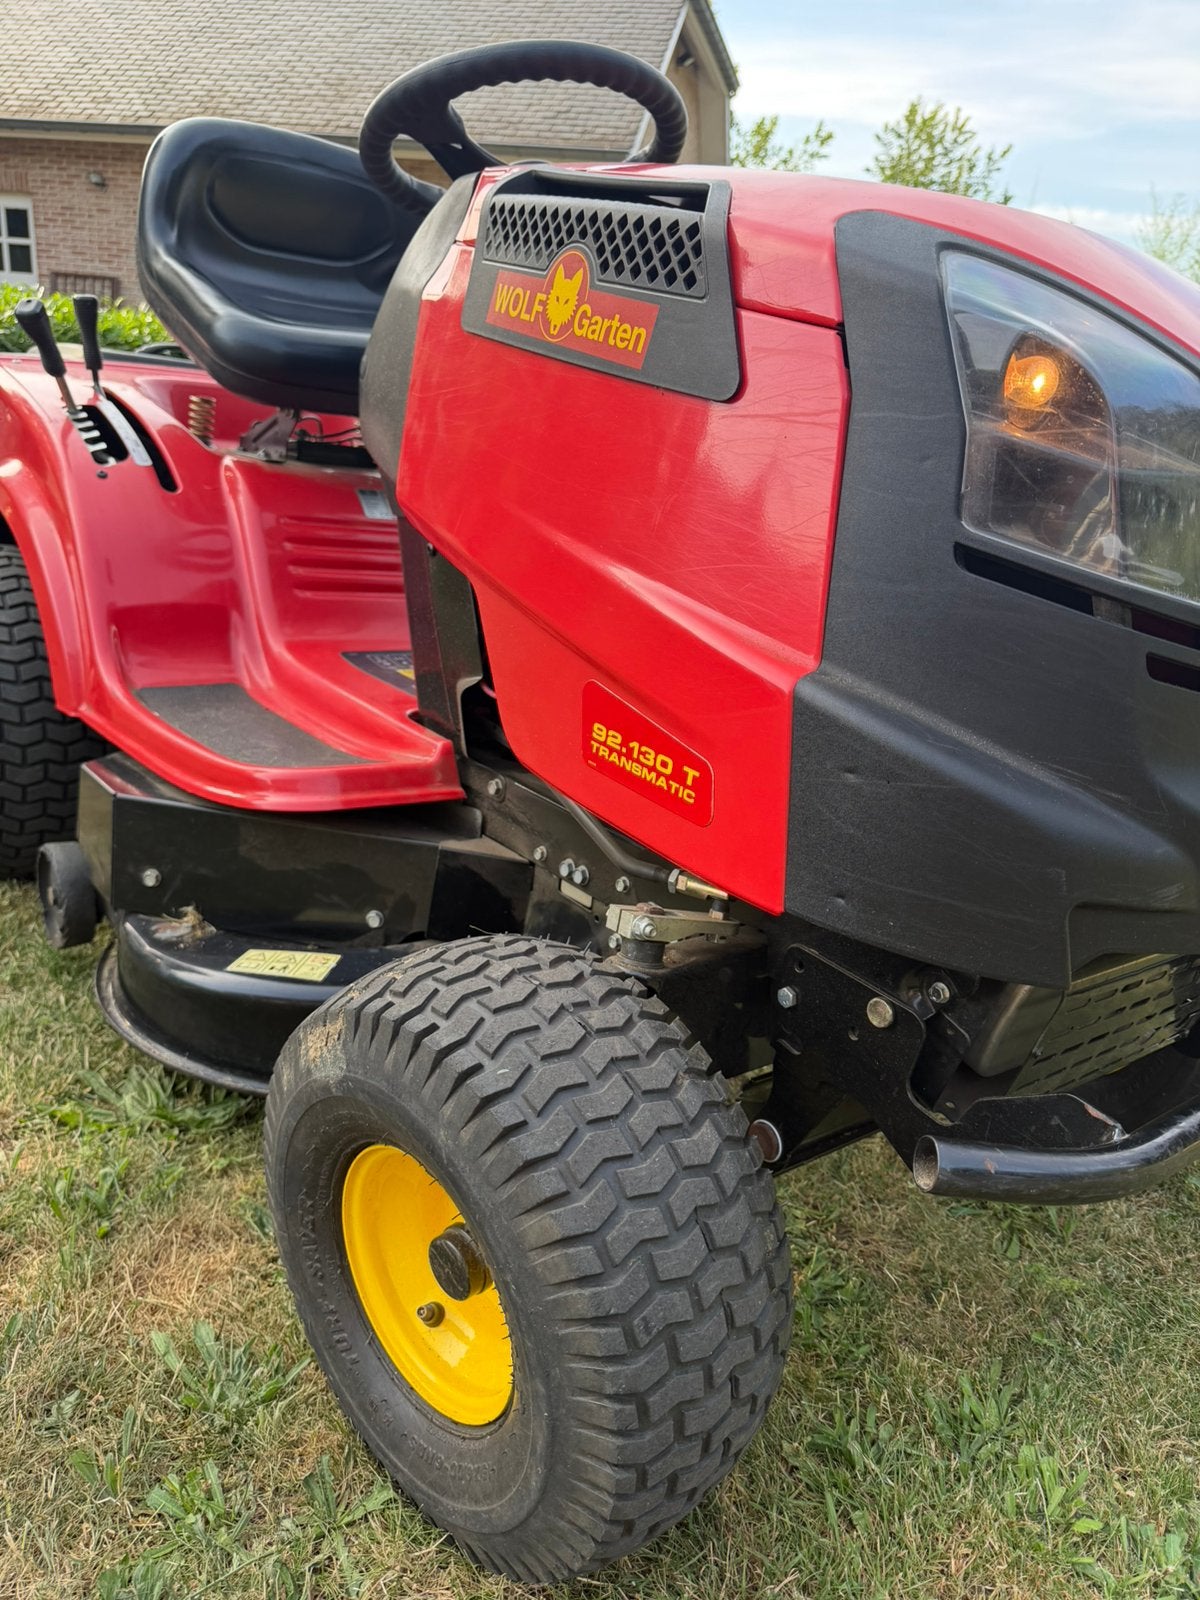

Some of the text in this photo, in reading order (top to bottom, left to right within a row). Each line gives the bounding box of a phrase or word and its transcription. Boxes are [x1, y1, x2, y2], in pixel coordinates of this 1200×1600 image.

[495, 284, 646, 353] WOLF Garten
[591, 741, 696, 803] TRANSMATIC
[592, 723, 700, 787] 92.130 T
